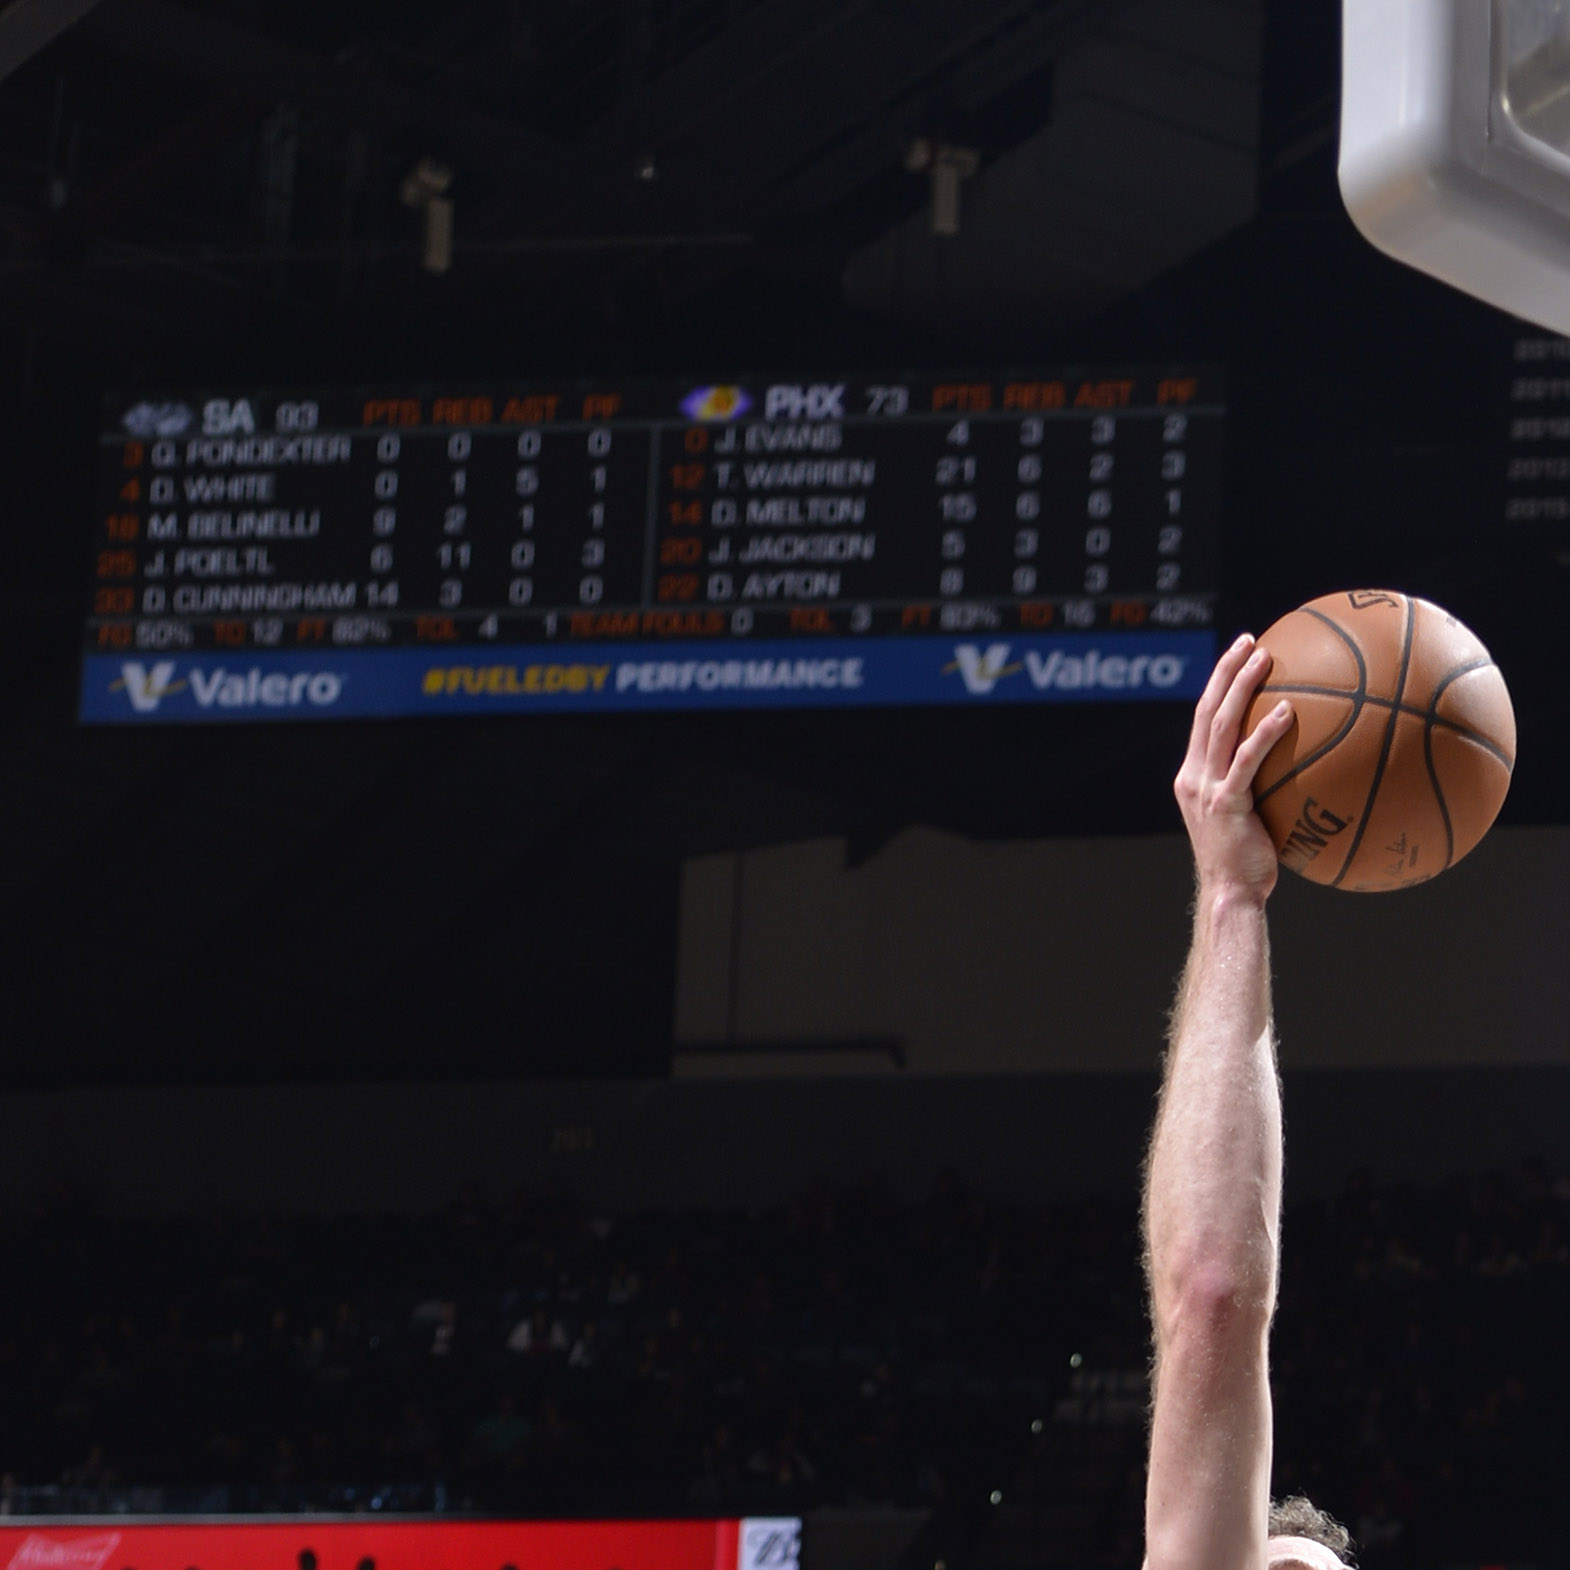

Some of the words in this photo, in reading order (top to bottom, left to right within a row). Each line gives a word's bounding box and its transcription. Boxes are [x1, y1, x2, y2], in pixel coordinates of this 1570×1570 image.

[202, 398, 255, 436] SA
[764, 384, 847, 420] PHX
[864, 385, 908, 416] 73
[376, 432, 400, 464] 0
[447, 430, 472, 462] 0
[517, 429, 542, 461] 0
[587, 427, 611, 459] 0
[945, 417, 970, 446] 4
[1162, 413, 1188, 444] 2
[184, 473, 276, 504] WHITE
[374, 469, 399, 501] 0
[451, 466, 467, 498] 1
[590, 464, 608, 494] 1
[743, 458, 876, 488] WARREN
[935, 455, 977, 487] 21
[1089, 451, 1115, 483] 2
[518, 502, 535, 532] 1
[589, 501, 605, 531] 1
[745, 497, 866, 526] MELTON
[1164, 488, 1181, 517] 1
[174, 546, 275, 576] POELTL
[436, 541, 472, 572] 11
[510, 538, 535, 570] 0
[740, 533, 876, 563] JACKSON
[1085, 525, 1111, 557] 0
[1157, 525, 1182, 555] 2
[508, 575, 533, 607] 0
[579, 574, 604, 606] 0
[741, 569, 841, 599] AYTON
[1156, 562, 1182, 592] 2
[189, 666, 342, 708] Valero
[423, 663, 609, 695] #FUELEDBY
[615, 657, 864, 692] PERFORMANCE
[1025, 648, 1187, 692] Valero
